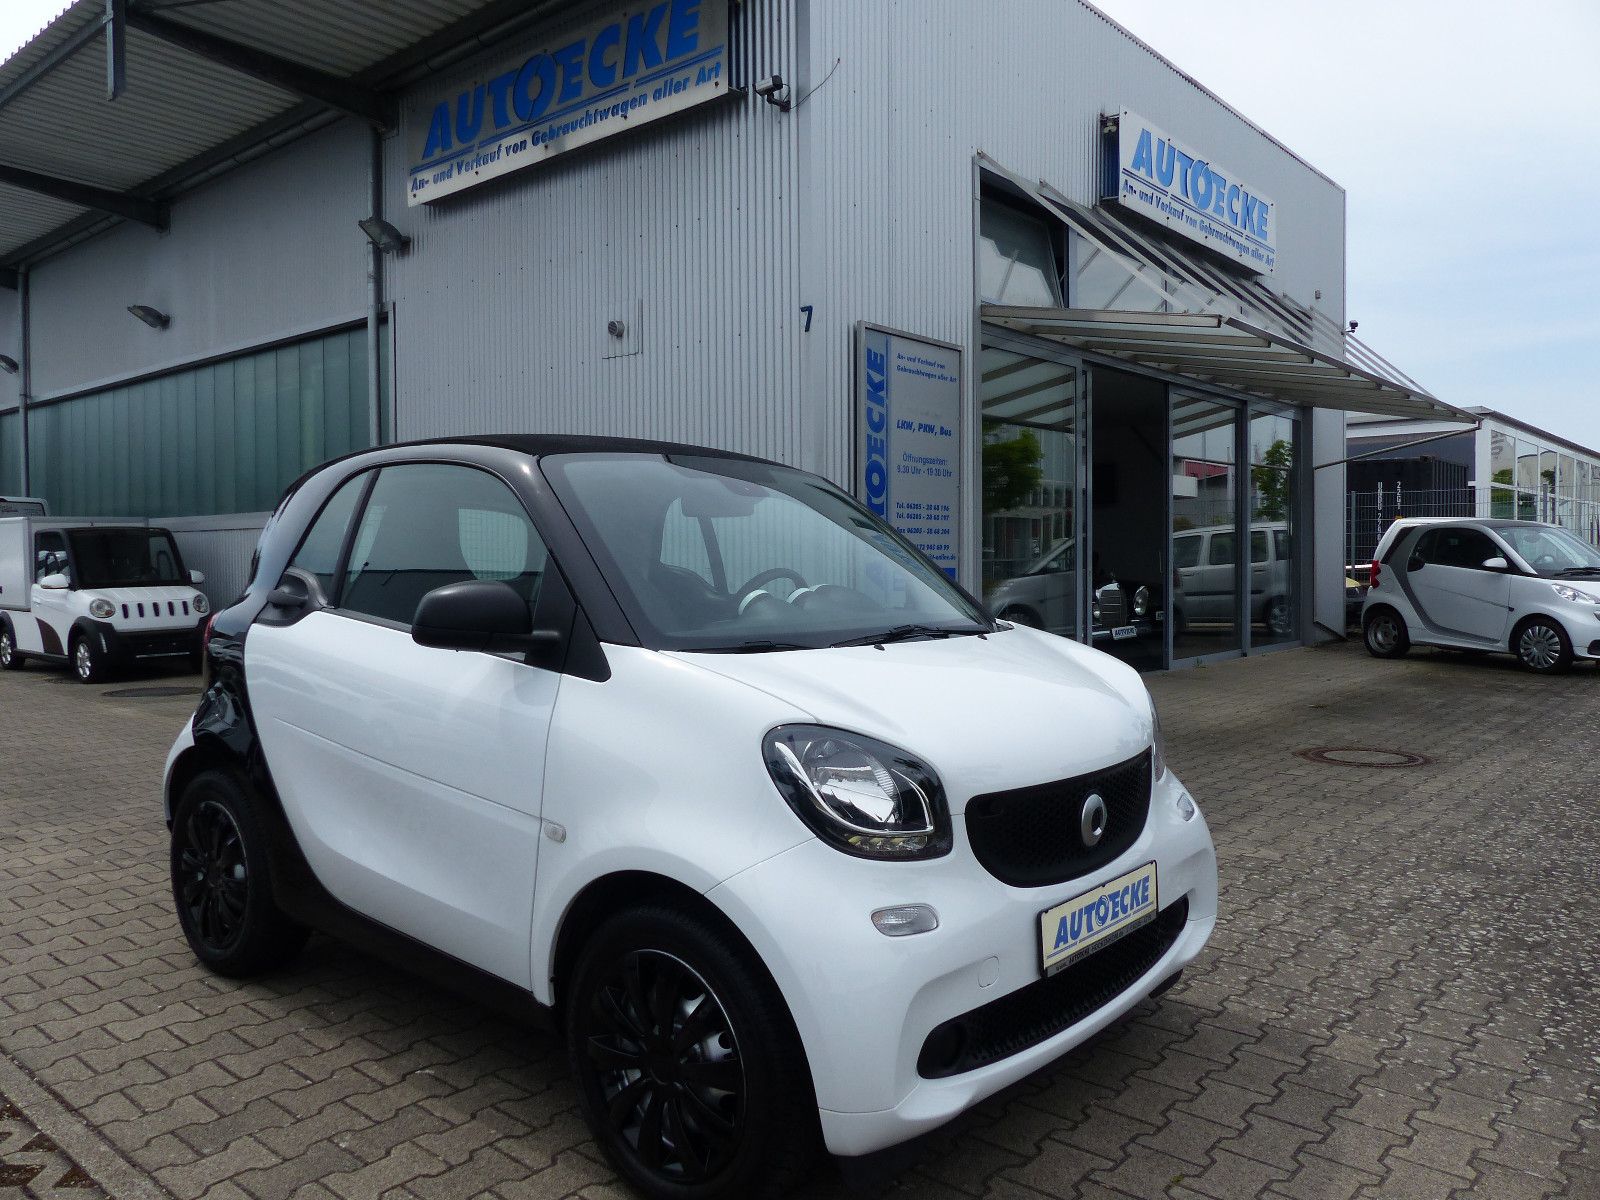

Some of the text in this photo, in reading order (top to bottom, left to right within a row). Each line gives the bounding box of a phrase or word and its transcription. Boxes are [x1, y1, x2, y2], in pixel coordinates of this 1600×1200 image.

[422, 0, 700, 160] AUTOECKE
[411, 60, 722, 193] An- und Verkauf von Gebrauchtwagen aller Art
[1122, 178, 1275, 268] An- und Verkauf von Gebrauchtwagen aller Art
[1131, 128, 1269, 241] AUTOECKE
[800, 304, 813, 333] 7
[865, 348, 886, 517] TOECKE
[896, 419, 952, 437] LKW, PKW, Bus
[910, 465, 922, 475] Uhr
[942, 468, 953, 478] Uhr
[1053, 875, 1150, 950] AUTOECKE
